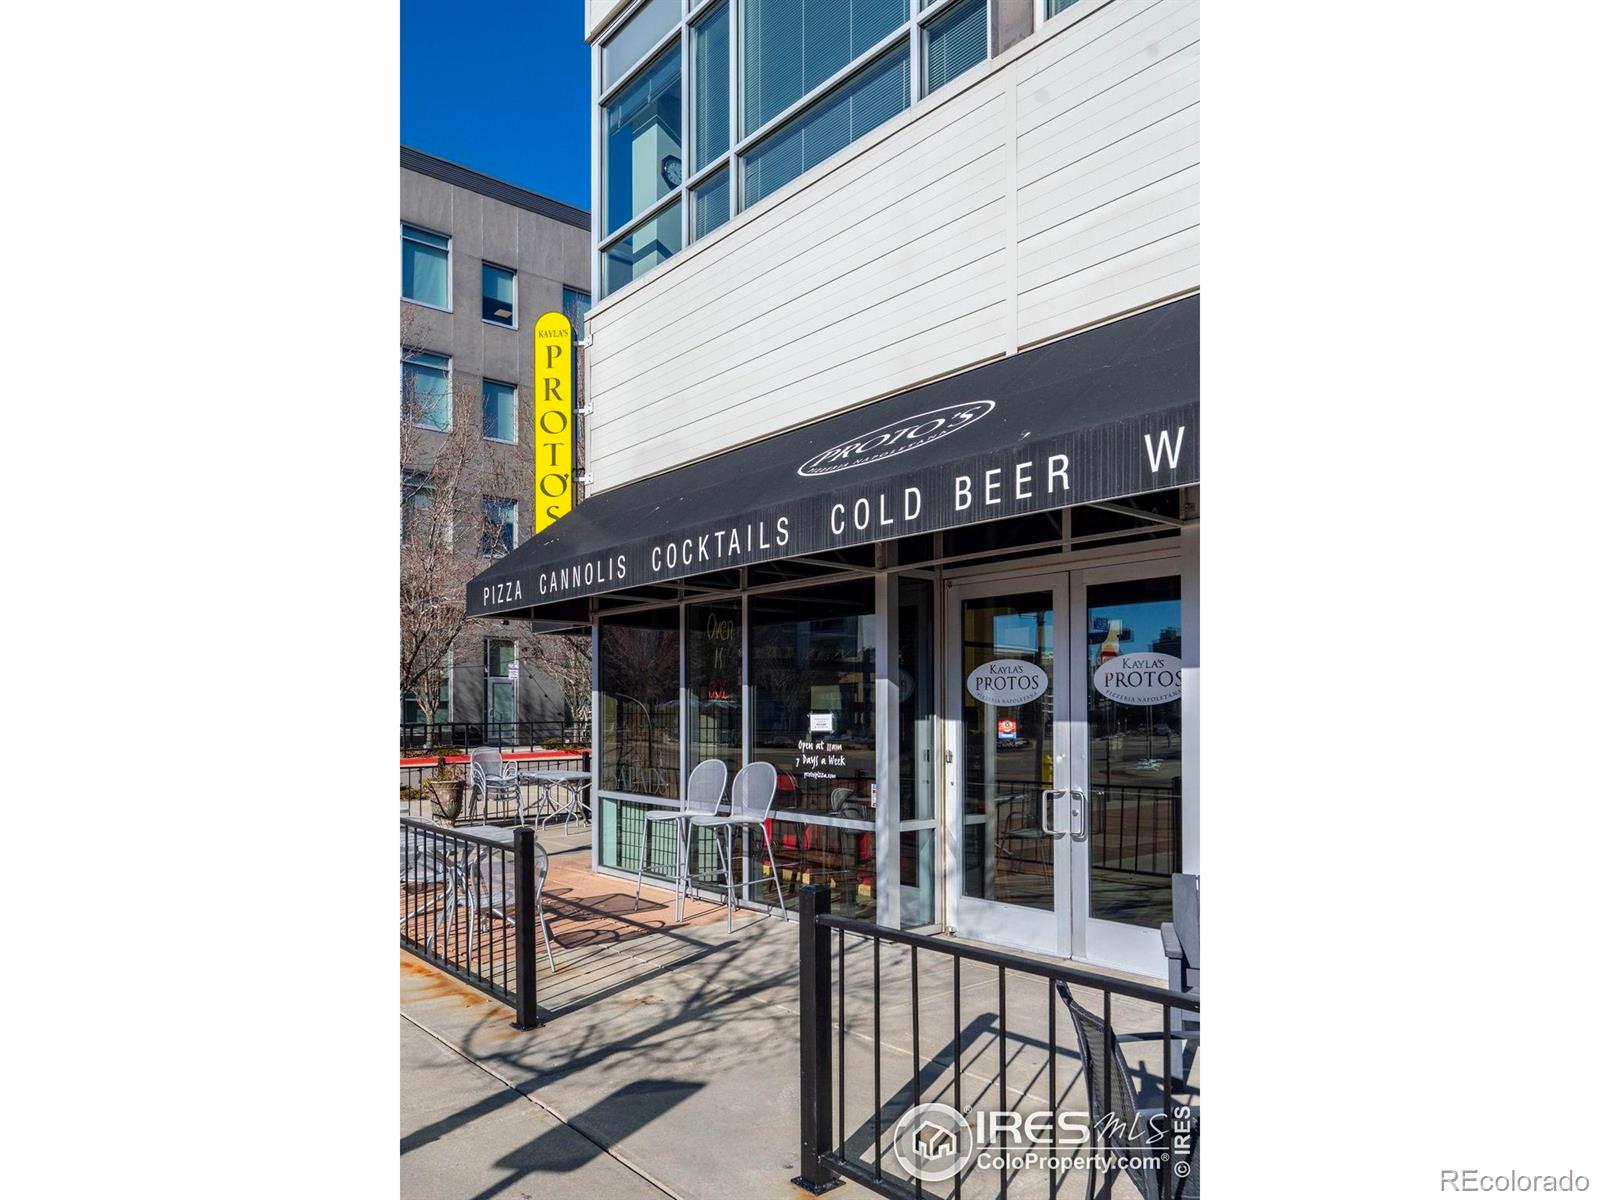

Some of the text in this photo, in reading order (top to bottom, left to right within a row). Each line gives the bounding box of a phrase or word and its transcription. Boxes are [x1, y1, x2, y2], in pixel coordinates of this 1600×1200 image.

[538, 329, 569, 339] KAYLA'S
[811, 405, 983, 467] PROTO'S
[483, 425, 1186, 606] PIZZA CANNOLIS COCKTAILS COLD BEER W
[989, 664, 1024, 675] KAYLA'S
[1122, 658, 1165, 669] KAYLA'S
[975, 675, 1039, 691] PROTOS
[1104, 670, 1183, 688] PROTOS
[798, 739, 814, 753] Open
[815, 740, 824, 751] at
[795, 757, 800, 768] 7
[820, 757, 827, 766] a
[828, 754, 847, 767] Week
